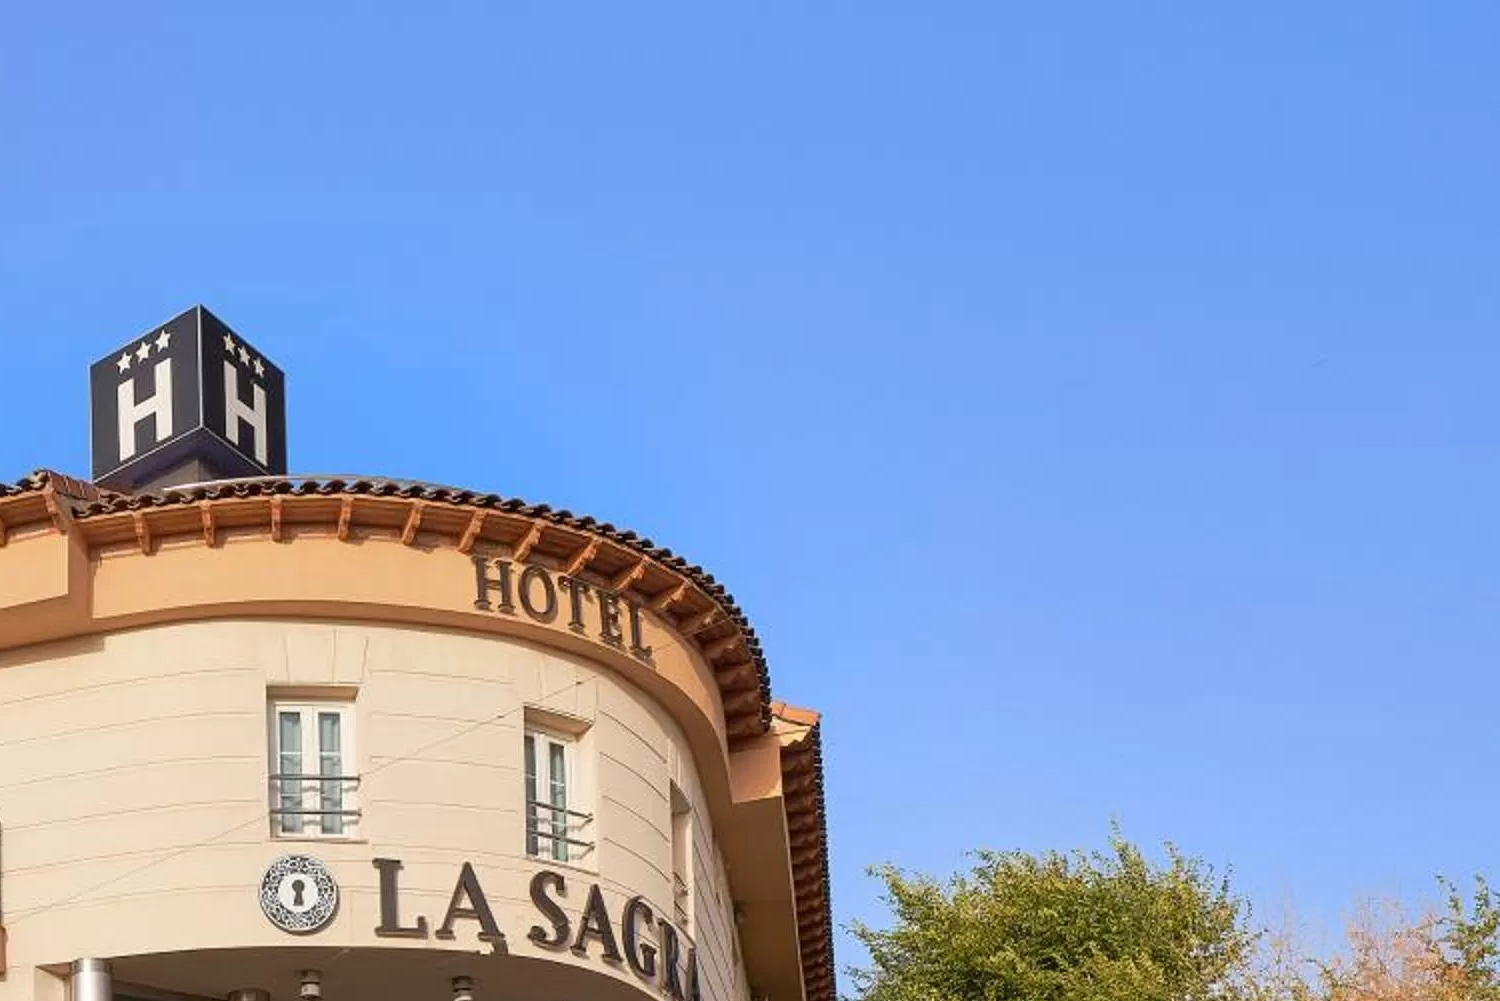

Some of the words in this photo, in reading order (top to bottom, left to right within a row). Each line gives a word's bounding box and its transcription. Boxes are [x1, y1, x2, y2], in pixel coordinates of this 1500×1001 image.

[117, 358, 173, 462] H
[223, 360, 268, 467] H
[471, 556, 654, 662] HOTEL
[373, 858, 505, 941] LA
